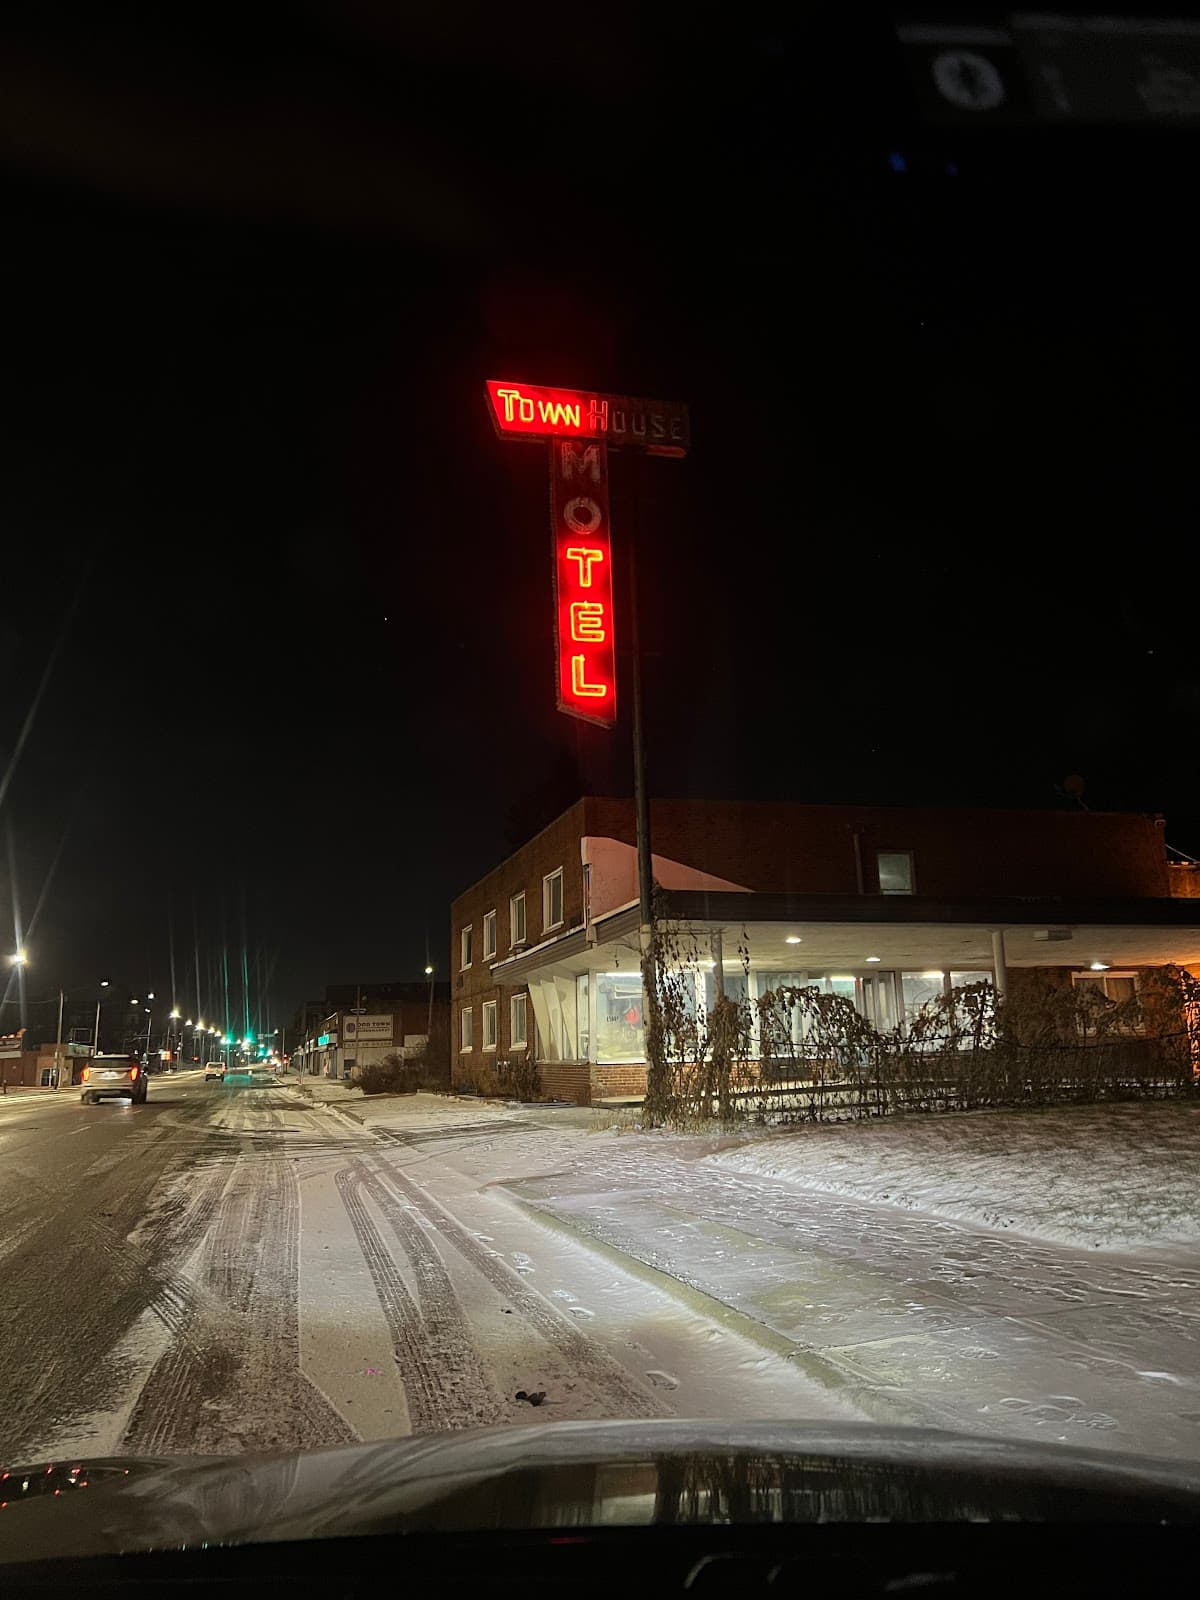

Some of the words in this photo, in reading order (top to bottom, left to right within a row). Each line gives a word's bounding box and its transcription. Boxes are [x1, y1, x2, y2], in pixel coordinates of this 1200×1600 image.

[497, 389, 580, 427] TOWN
[587, 399, 682, 439] HOUSE
[561, 441, 607, 697] MOTEL
